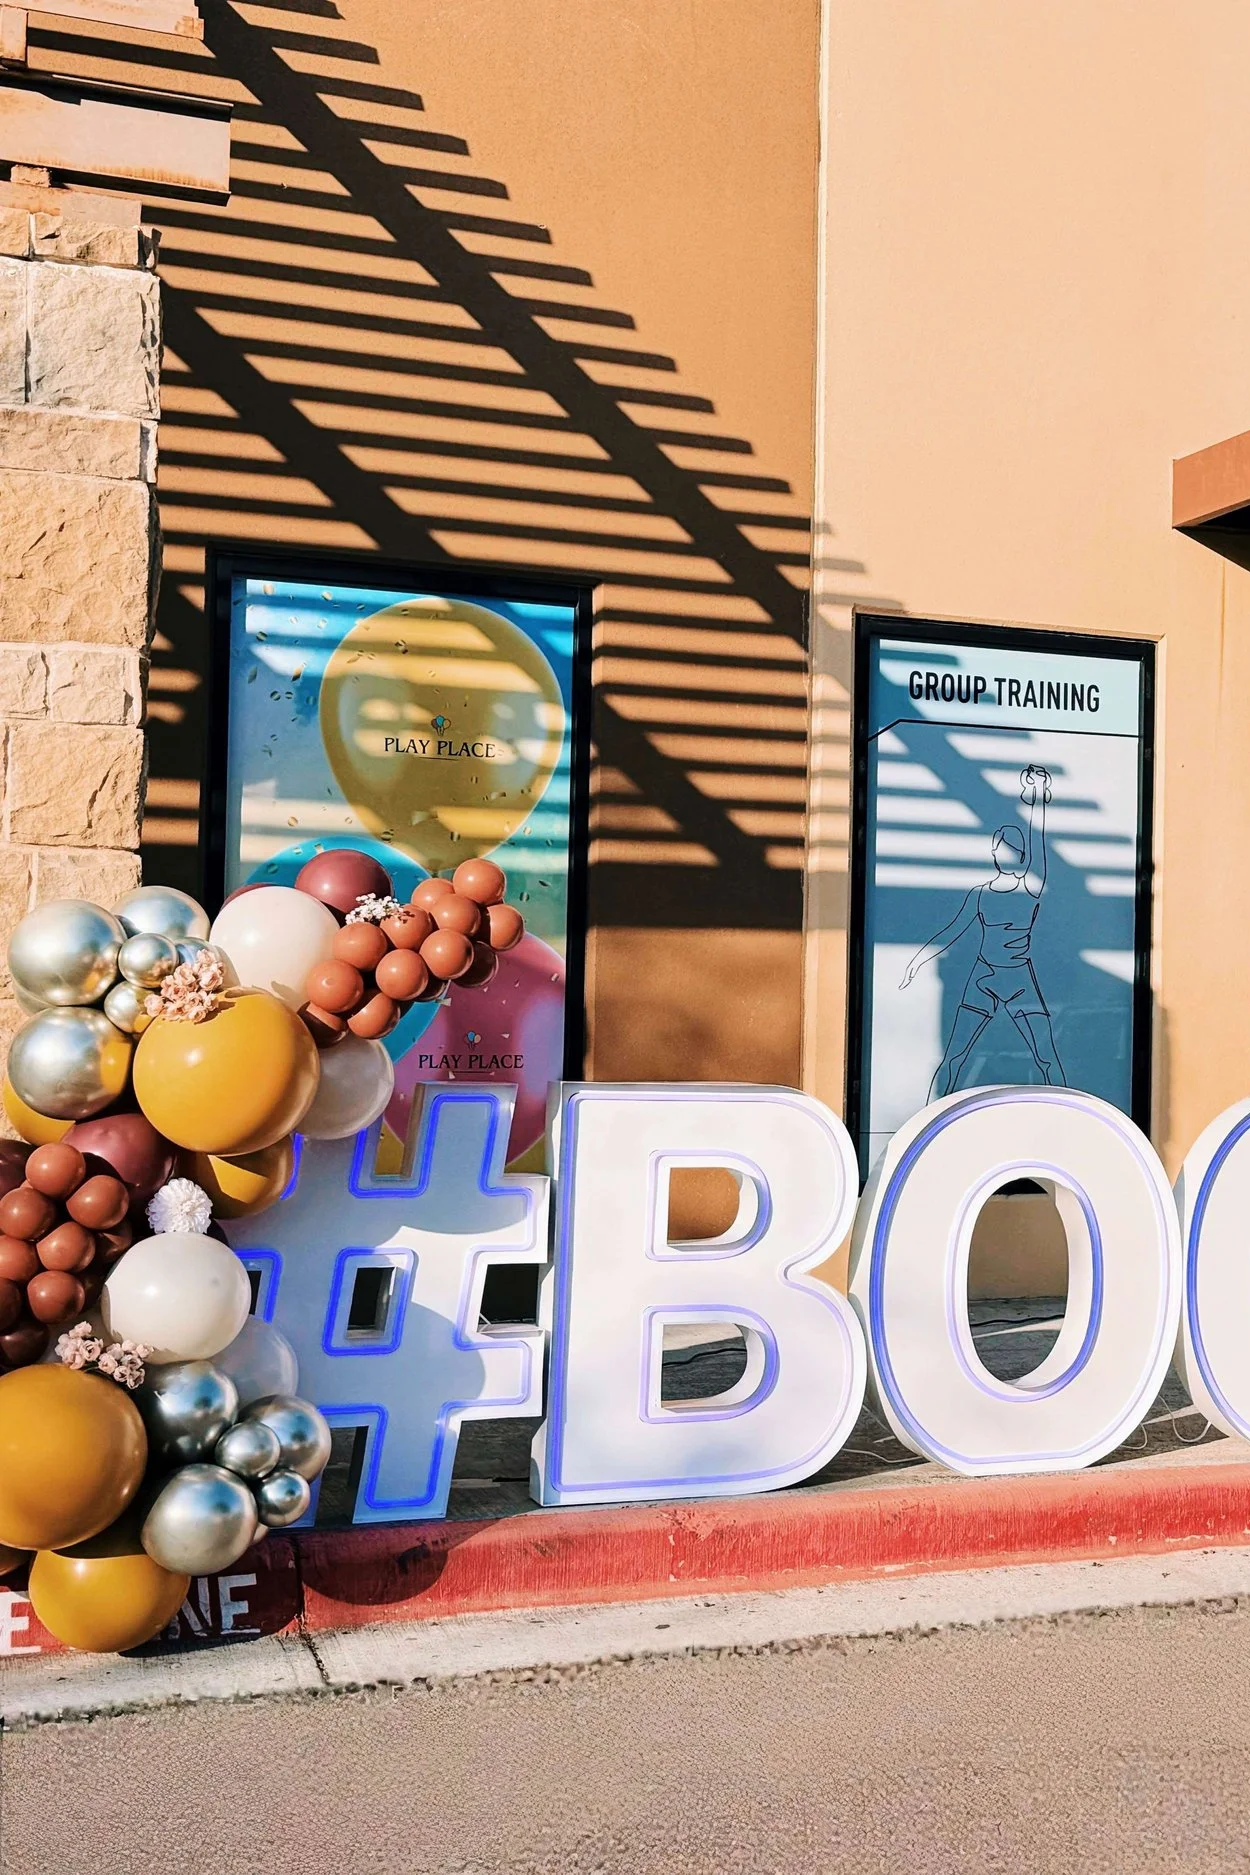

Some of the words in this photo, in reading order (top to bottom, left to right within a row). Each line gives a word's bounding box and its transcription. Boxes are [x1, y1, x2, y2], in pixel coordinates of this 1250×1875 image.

[909, 670, 987, 704] GROUP
[994, 677, 1101, 713] TRAINING
[384, 737, 430, 754] PLAY
[437, 740, 496, 758] PLACE
[418, 1055, 462, 1069] PLAY
[468, 1055, 524, 1069] PLACE
